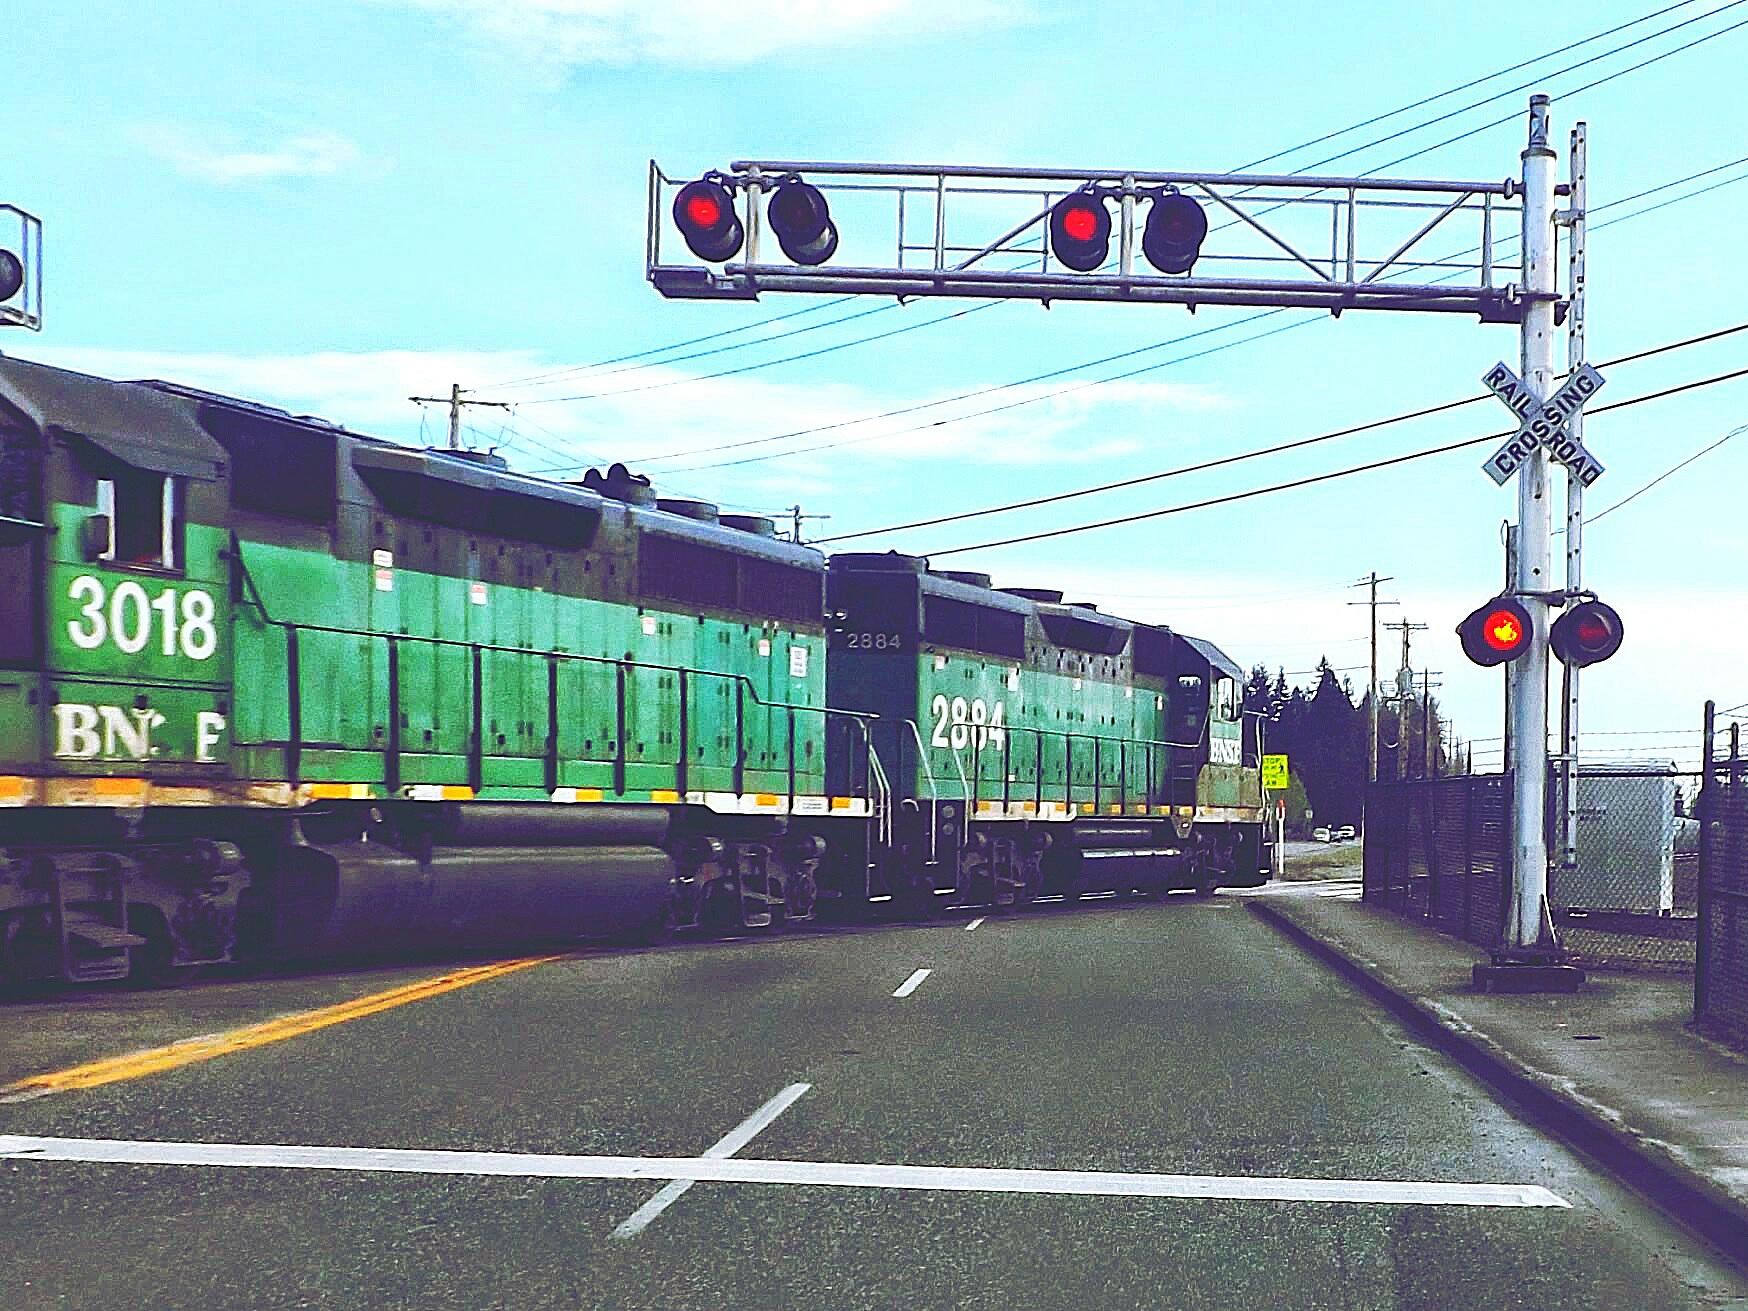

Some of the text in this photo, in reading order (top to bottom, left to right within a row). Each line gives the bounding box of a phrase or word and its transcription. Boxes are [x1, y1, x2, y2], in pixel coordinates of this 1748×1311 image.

[1487, 367, 1600, 485] RAIL ROAD
[1495, 375, 1595, 474] CROSSING
[68, 575, 217, 660] 3018
[847, 633, 901, 649] 2884
[54, 703, 226, 763] BNF
[931, 694, 1006, 751] 2884
